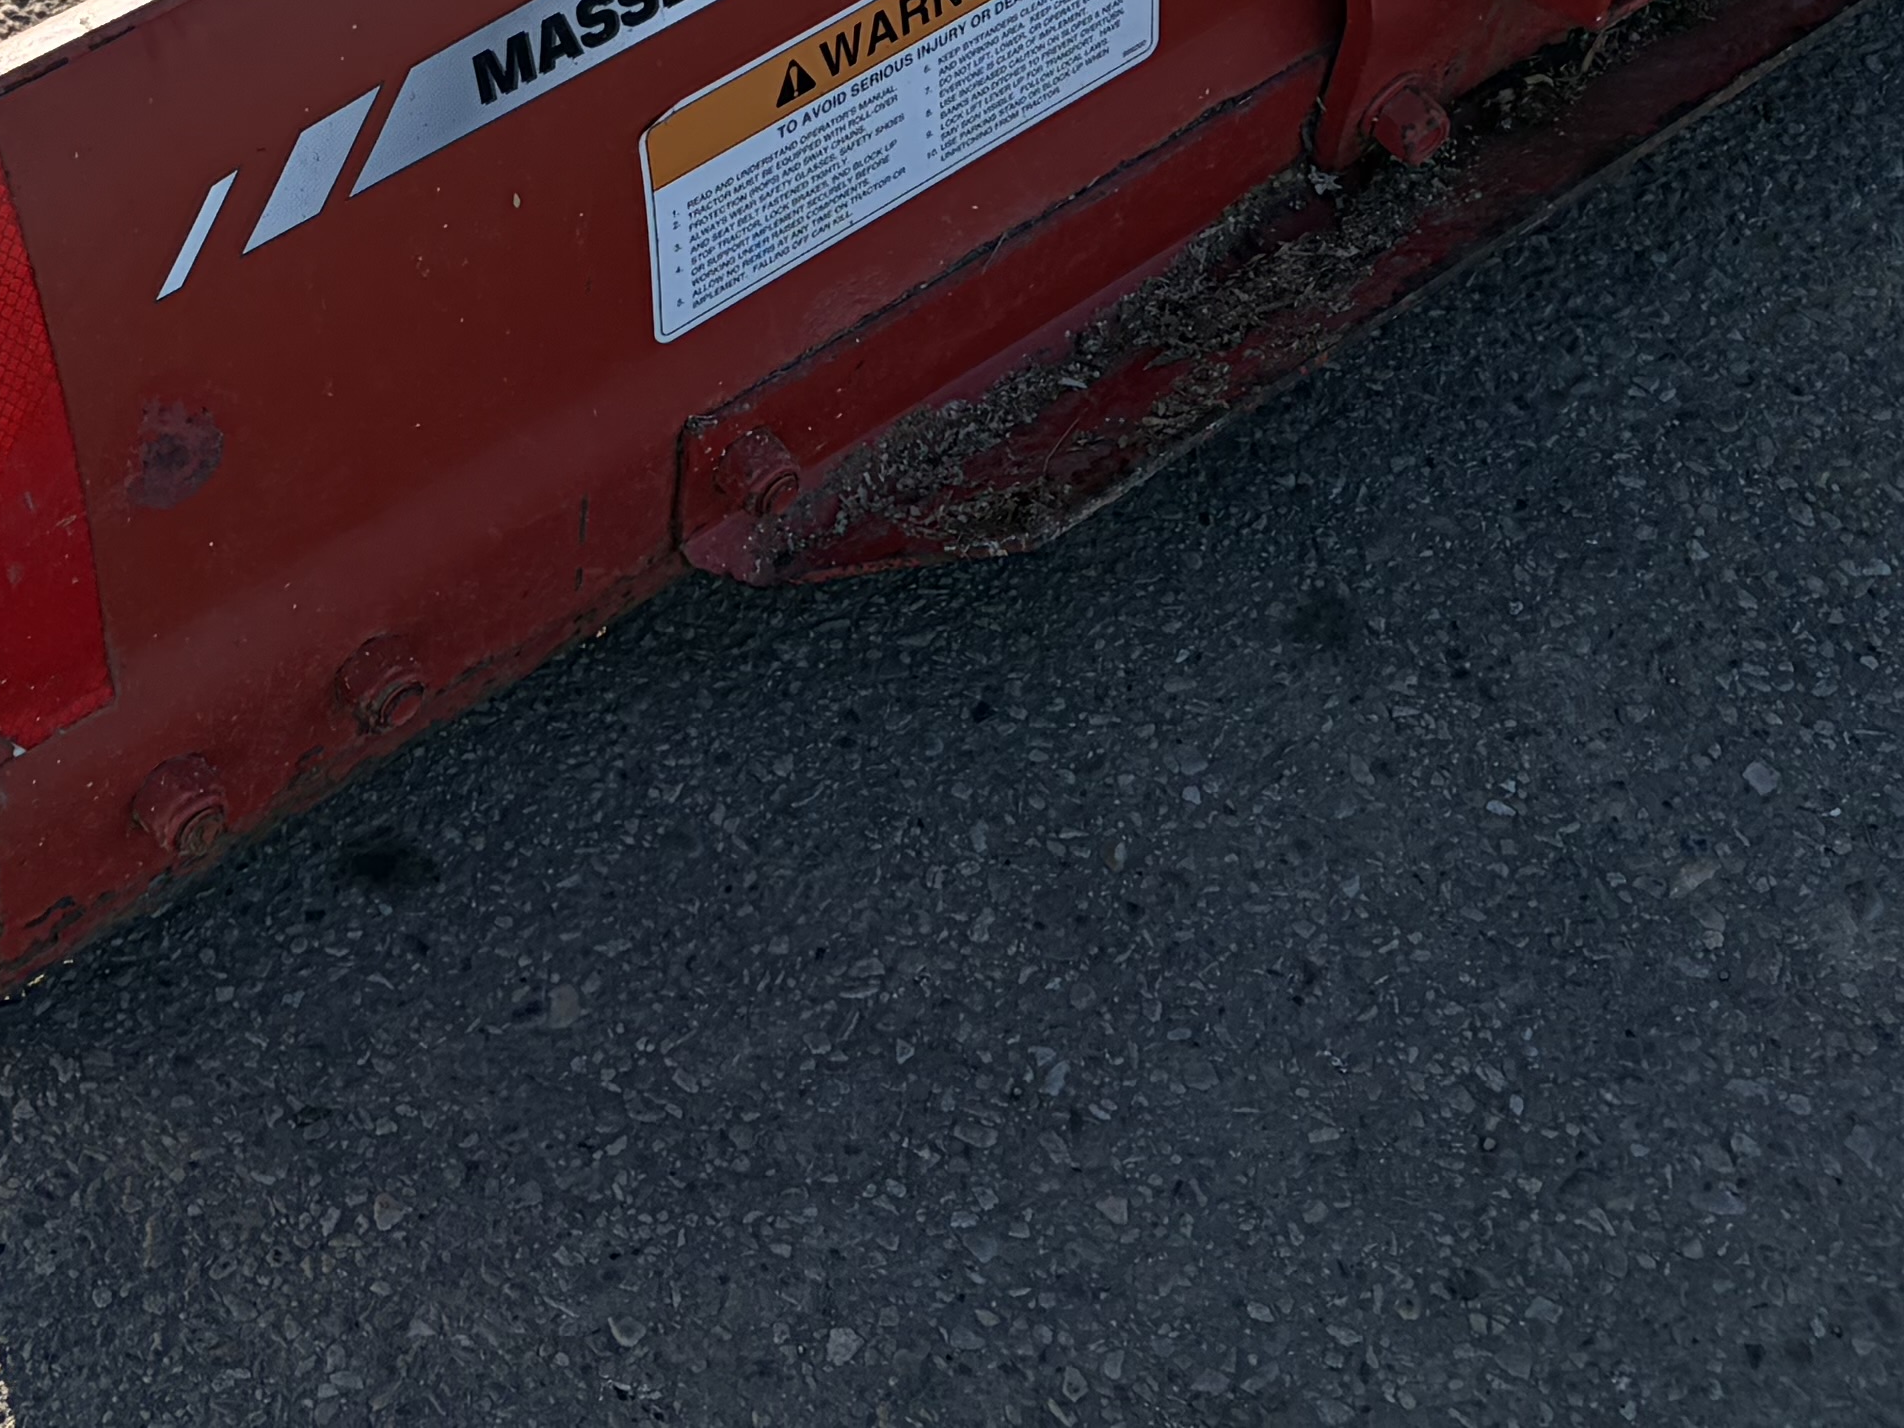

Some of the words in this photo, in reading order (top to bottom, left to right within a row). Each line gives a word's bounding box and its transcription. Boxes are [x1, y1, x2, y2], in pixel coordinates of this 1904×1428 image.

[776, 116, 798, 141] TO
[800, 88, 846, 127] AVOID
[850, 50, 913, 99] SERIOUS
[916, 21, 966, 61] INJURY
[969, 7, 990, 31] OR
